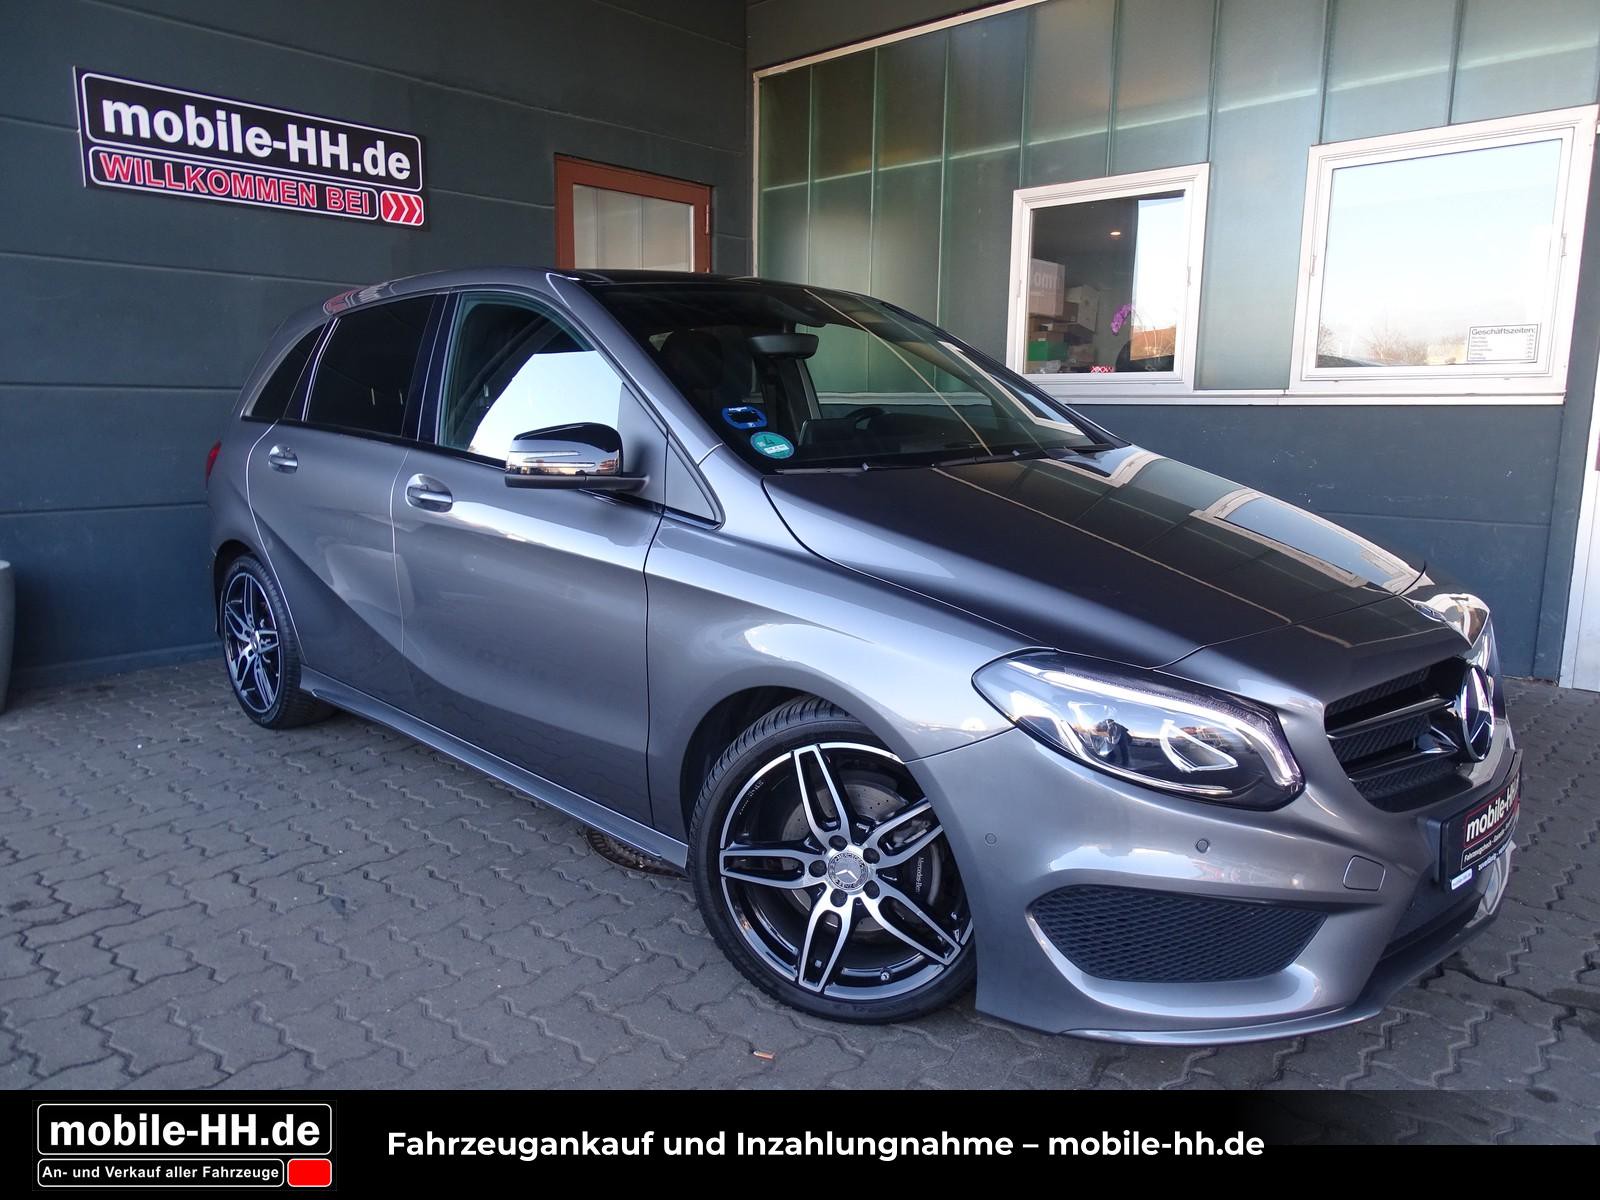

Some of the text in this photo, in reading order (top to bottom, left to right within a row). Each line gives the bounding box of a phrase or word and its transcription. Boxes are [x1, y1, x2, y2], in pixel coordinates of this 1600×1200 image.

[101, 99, 411, 180] mobile-HH.de
[100, 153, 370, 215] WILLKOMMEN BEI
